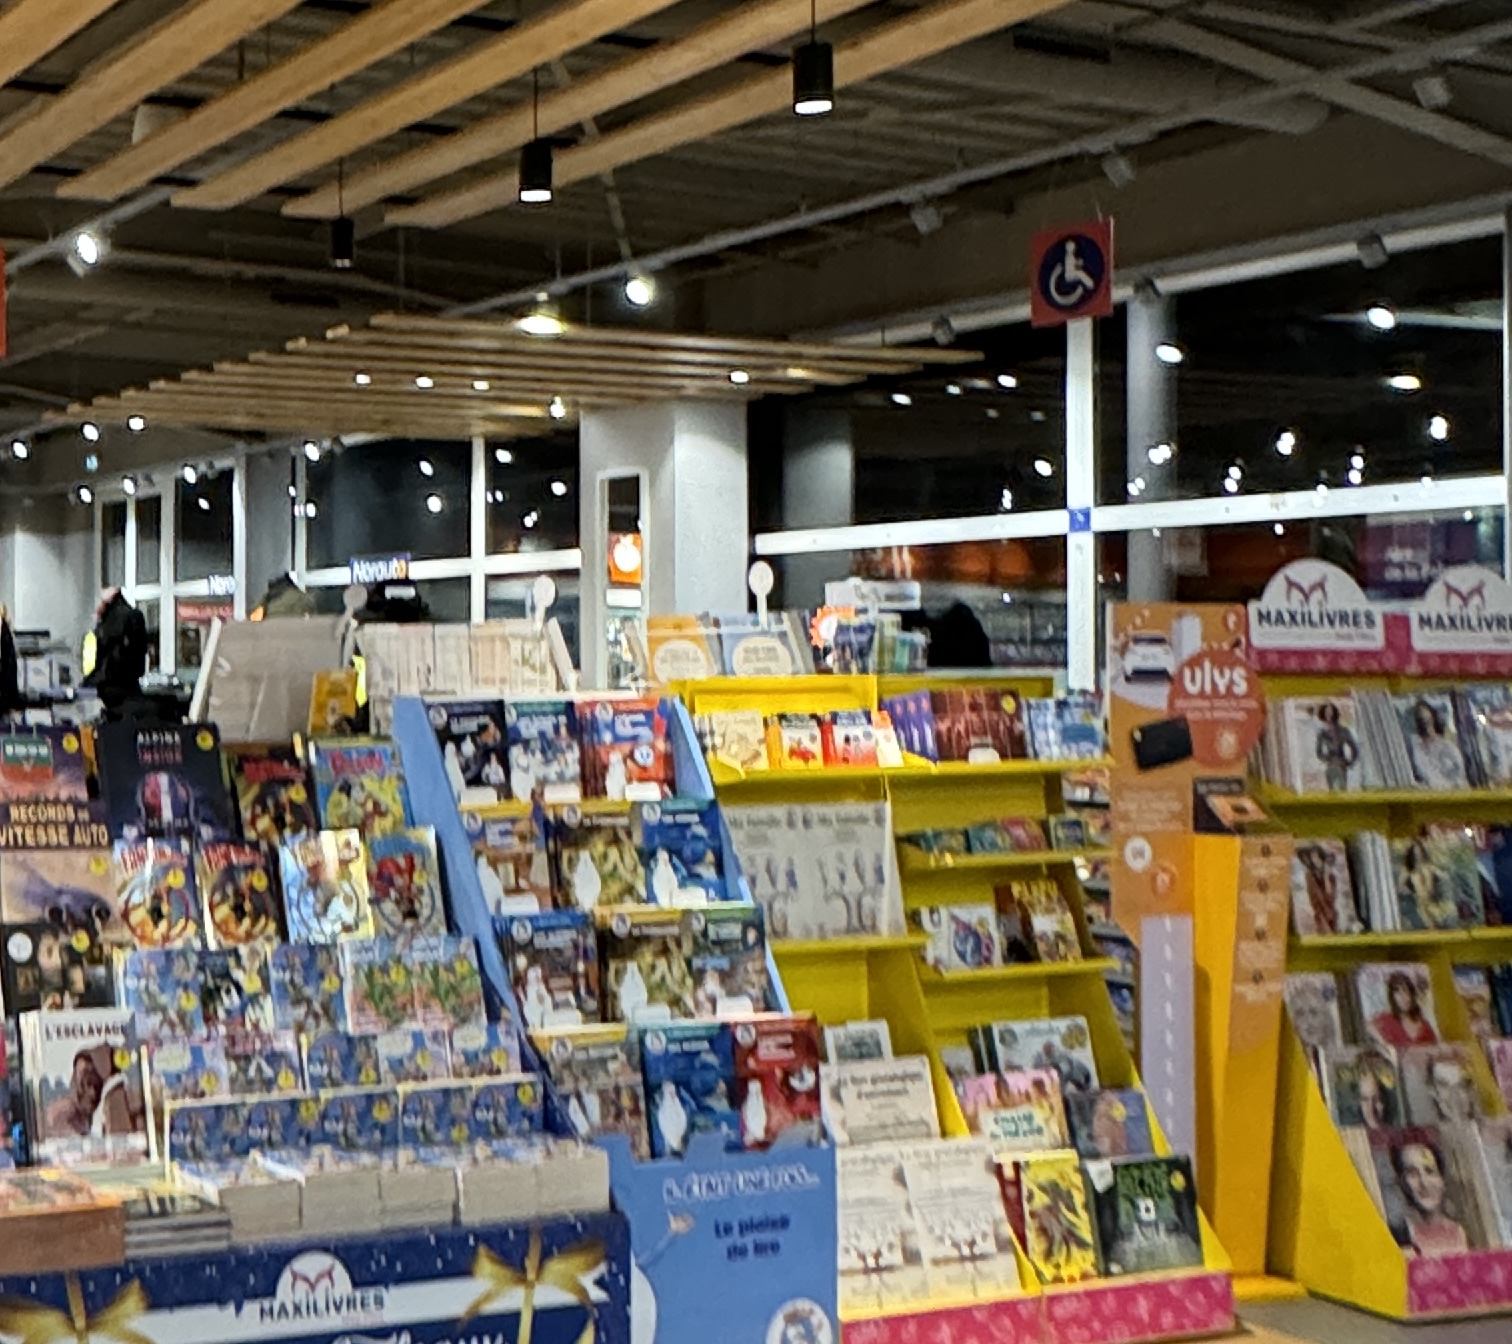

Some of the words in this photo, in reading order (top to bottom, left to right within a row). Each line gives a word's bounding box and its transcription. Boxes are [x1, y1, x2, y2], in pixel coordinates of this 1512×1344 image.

[351, 555, 407, 584] Norauto
[1256, 599, 1377, 629] MAXILIVRES
[1418, 604, 1512, 633] MAXILIVRE
[1183, 658, 1249, 697] ulys
[9, 803, 76, 824] RECORDS
[73, 823, 110, 847] AUTO
[258, 1286, 386, 1324] MAXILIVRES
